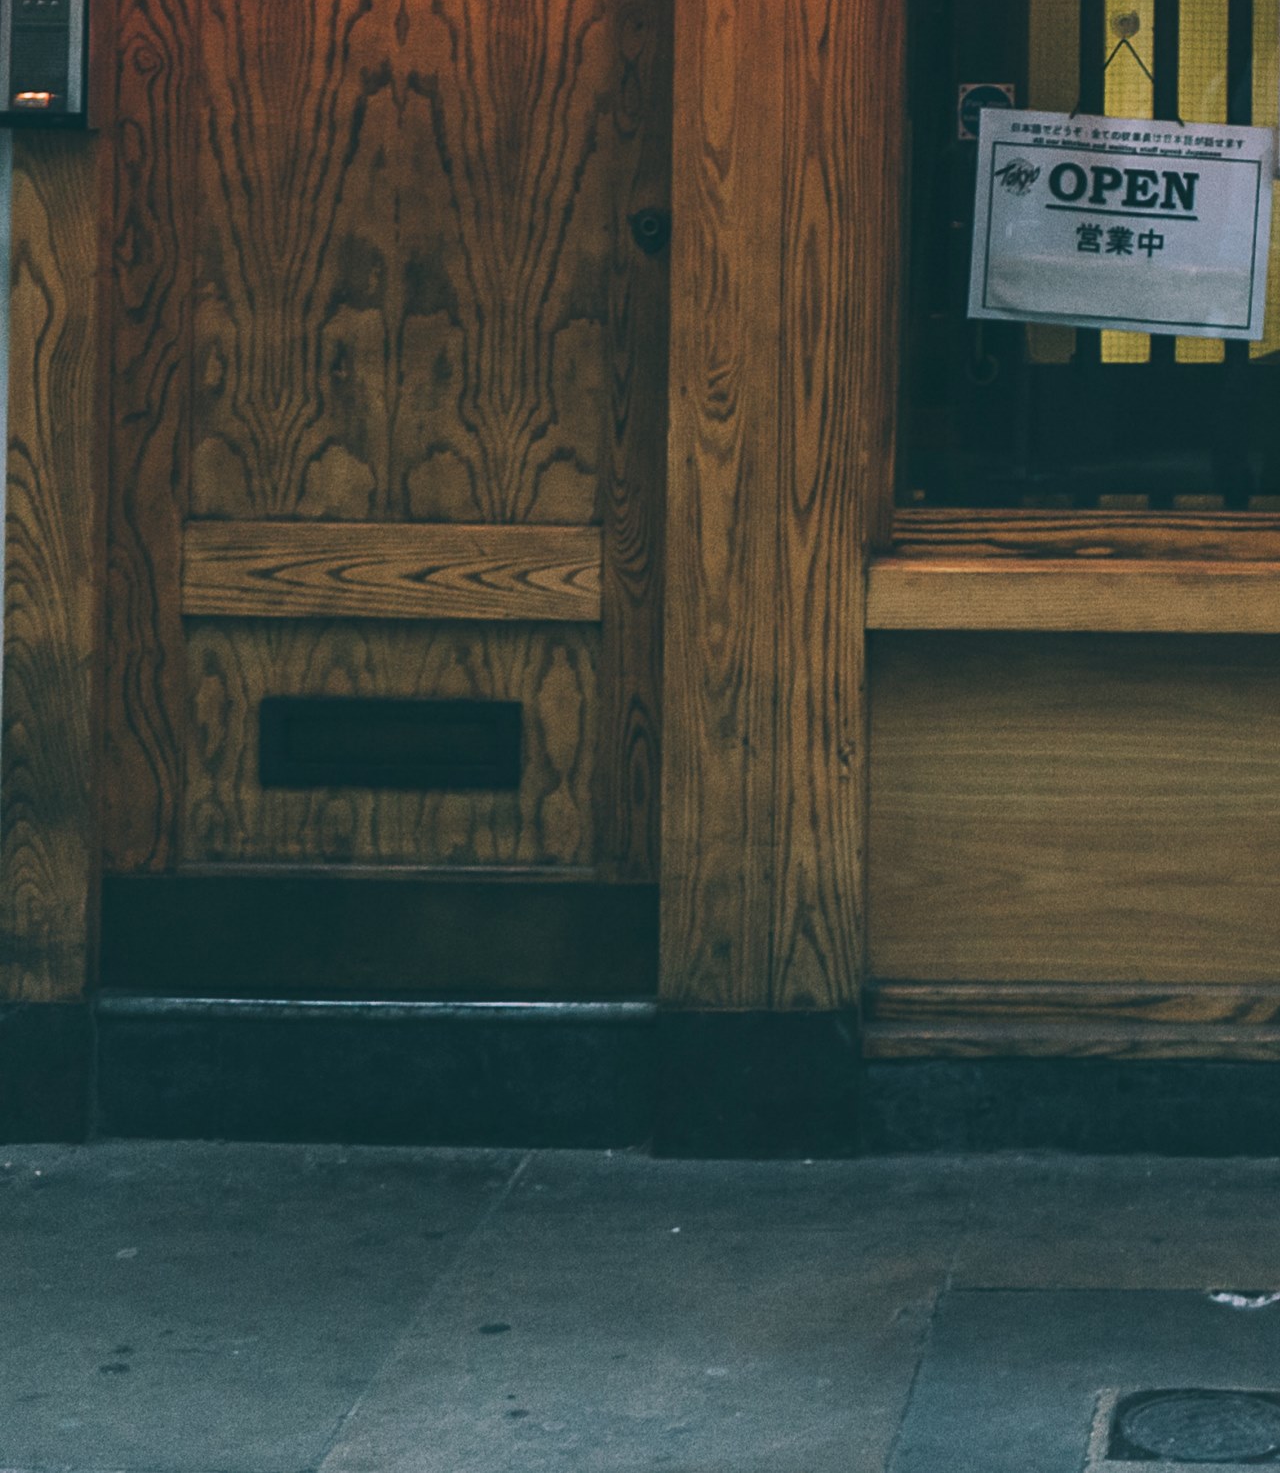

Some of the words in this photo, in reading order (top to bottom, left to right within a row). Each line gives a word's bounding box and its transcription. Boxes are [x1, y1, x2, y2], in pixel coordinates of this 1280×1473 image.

[994, 162, 1041, 193] Tokyo
[1048, 162, 1200, 211] OPEN
[1076, 223, 1165, 258] 営業中
